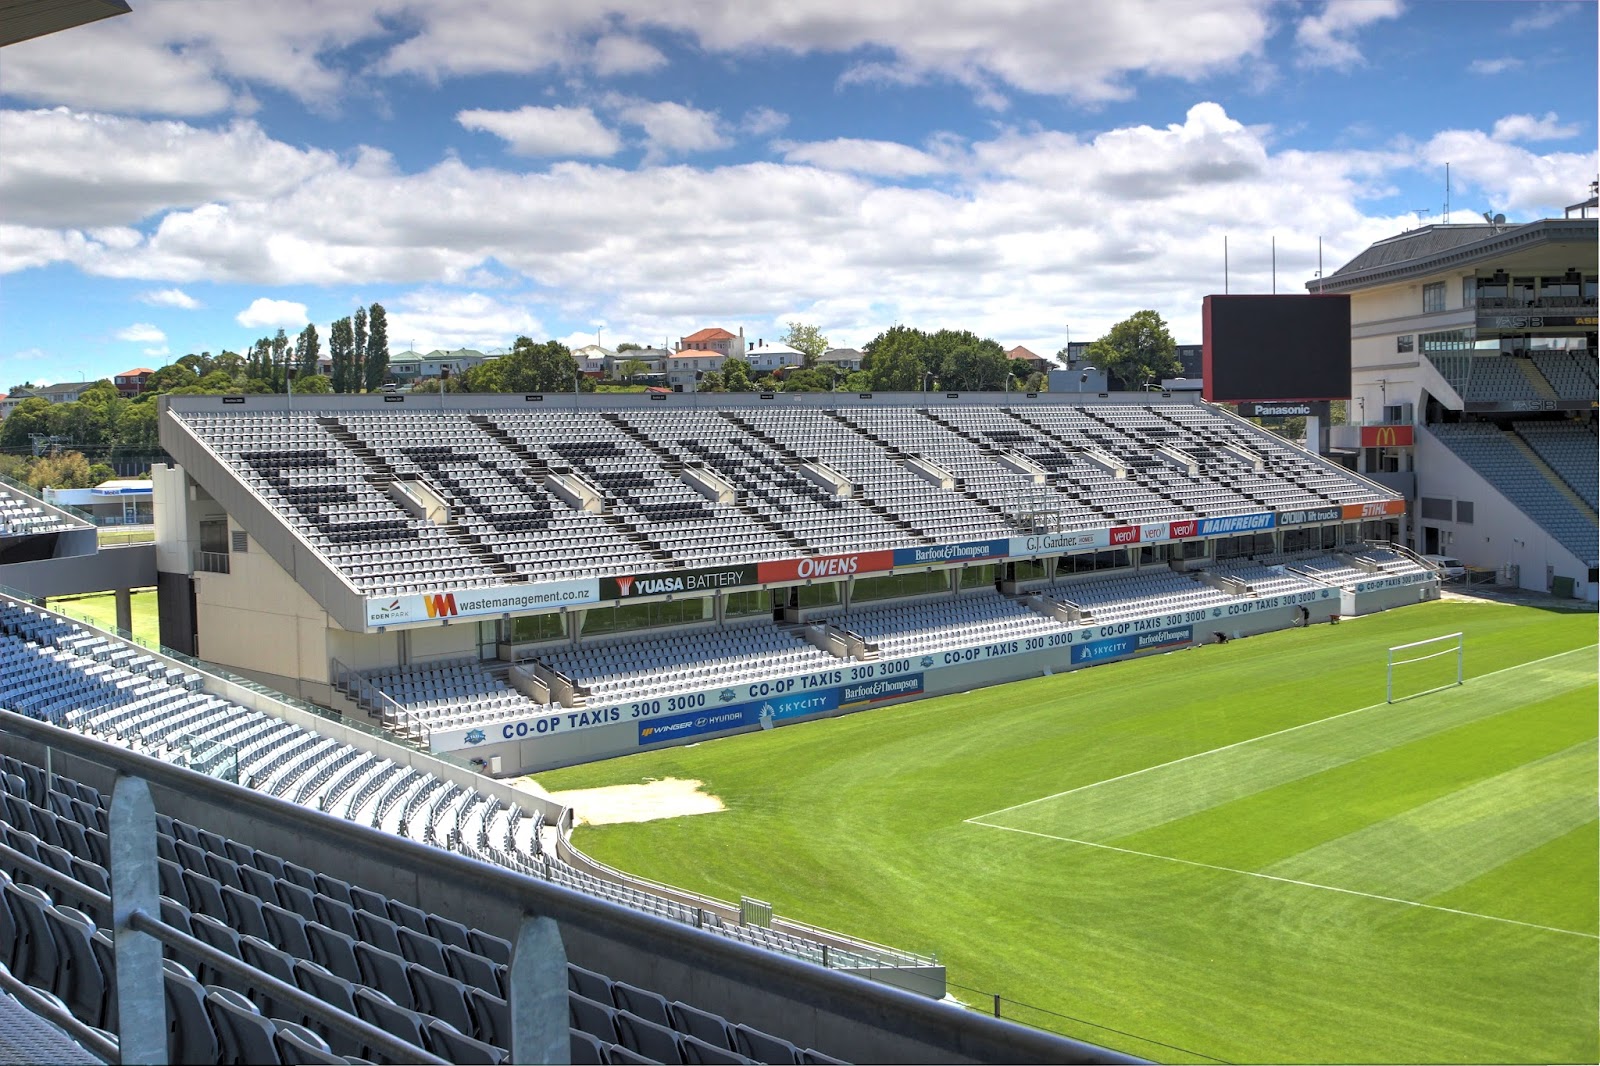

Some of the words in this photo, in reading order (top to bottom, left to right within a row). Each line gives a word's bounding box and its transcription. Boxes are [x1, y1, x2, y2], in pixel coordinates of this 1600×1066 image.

[1496, 316, 1544, 328] ASB
[1255, 404, 1310, 415] Panasonic
[1512, 400, 1557, 411] ASB
[1308, 511, 1317, 522] lift
[1317, 510, 1338, 520] trucks
[1361, 503, 1387, 516] STIHL
[1174, 526, 1189, 536] vero
[1202, 514, 1271, 533] MAINFREIGHT
[1114, 531, 1131, 541] vero
[1144, 529, 1161, 538] vero
[1026, 538, 1042, 552] G.J.
[797, 556, 858, 578] OWENS
[635, 578, 684, 594] YUASA
[687, 571, 744, 590] BATTERY
[1367, 581, 1384, 590] CO-OP
[1385, 578, 1400, 586] TAXIS
[1402, 576, 1411, 584] 300
[460, 590, 590, 611] wastemanagement.co.nz
[1228, 602, 1253, 615] CO-OP
[1256, 598, 1278, 610] TAXIS
[1282, 594, 1296, 606] 300
[1299, 592, 1316, 602] 3000
[1100, 622, 1130, 637] CO-OP
[1134, 618, 1161, 631] TAXIS
[1166, 614, 1182, 626] 300
[1186, 610, 1206, 622] 3000
[944, 650, 980, 664] CO-OP
[985, 642, 1018, 657] TAXIS
[1026, 637, 1044, 650] 300
[1048, 632, 1073, 646] 3000
[1094, 642, 1127, 655] SKYCITY
[749, 678, 794, 698] CO-OP
[801, 670, 842, 689] TAXIS
[851, 665, 874, 680] 300
[880, 660, 910, 675] 3000
[779, 696, 827, 713] SKYCITY
[503, 717, 560, 739] CO-OP
[568, 707, 620, 728] TAXIS
[632, 700, 660, 718] 300
[668, 693, 706, 711] 3000
[654, 720, 692, 734] WINGER
[708, 712, 742, 724] HYUNDAI
